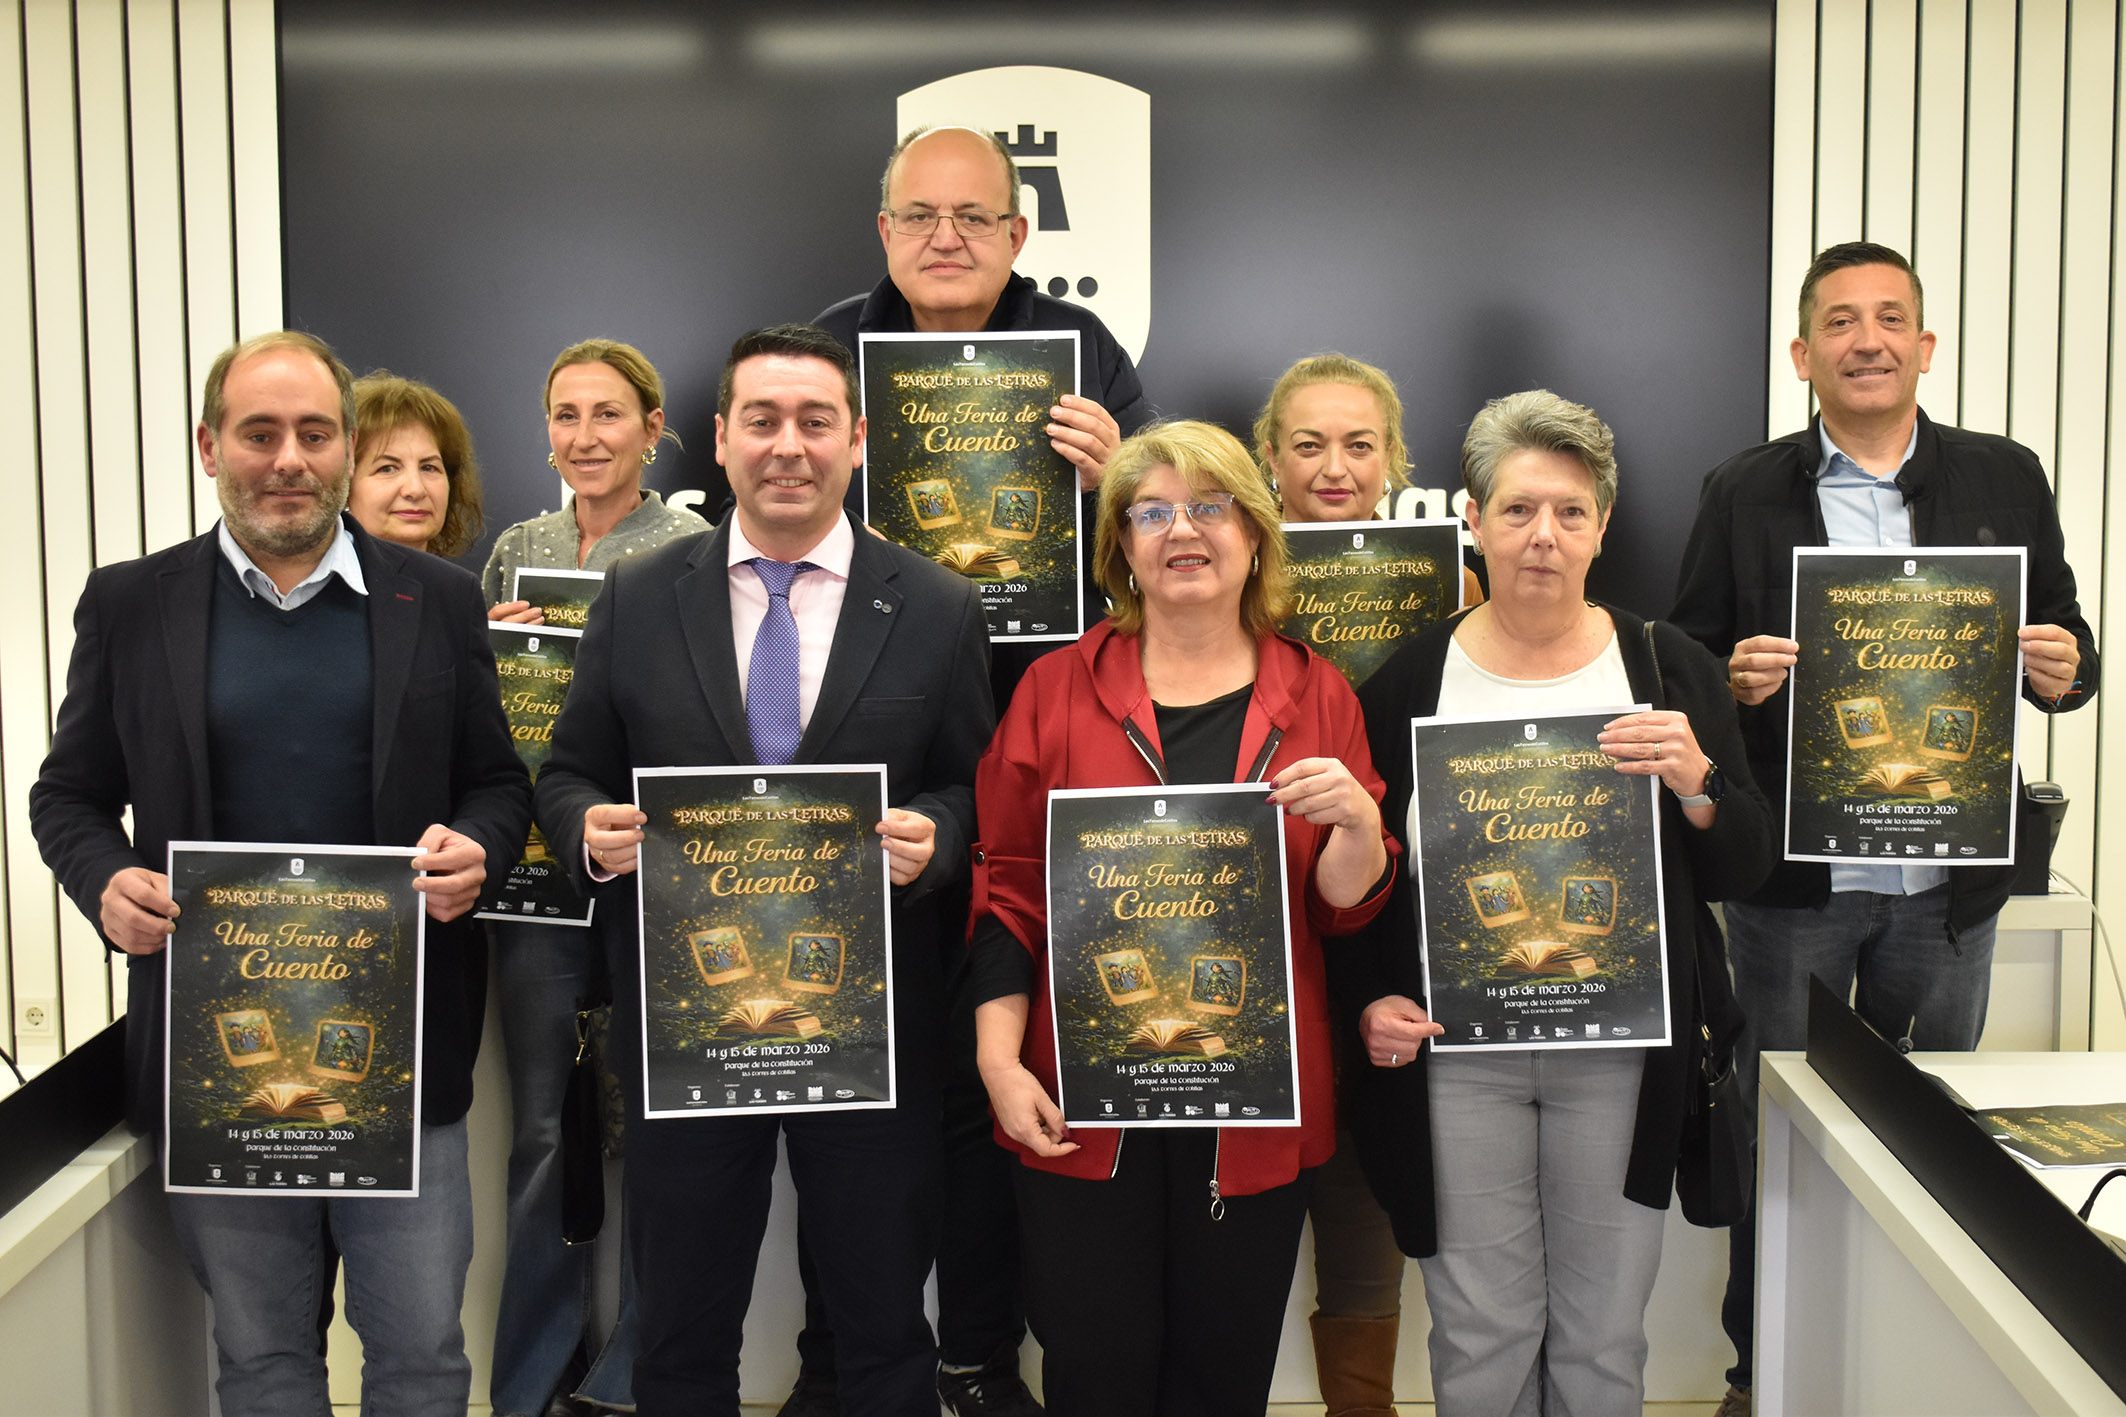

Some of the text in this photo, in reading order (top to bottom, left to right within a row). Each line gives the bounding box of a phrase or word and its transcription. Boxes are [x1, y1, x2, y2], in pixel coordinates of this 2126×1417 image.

[957, 377, 971, 385] DE
[993, 374, 1047, 388] LETRAS
[901, 403, 1038, 424] Una Feria de
[924, 426, 1020, 451] Cuento
[1345, 566, 1359, 575] DE
[1362, 566, 1380, 574] LAS
[1380, 561, 1433, 576] LETRAS
[980, 583, 1028, 593] rzo 2026
[1895, 593, 1910, 601] DE
[1913, 594, 1933, 602] LAS
[1933, 590, 1991, 605] LETRAS
[1291, 591, 1423, 615] Una Feria de
[545, 608, 588, 623] PARQU
[1311, 616, 1404, 644] Cuento
[1834, 619, 1980, 641] Una Feria de
[1857, 643, 1960, 671] Cuento
[518, 668, 532, 676] DE
[535, 669, 552, 679] LAS
[510, 692, 561, 715] Feria
[509, 719, 555, 742] ent
[1518, 759, 1533, 768] DE
[1537, 758, 1558, 767] LAS
[1459, 785, 1610, 813] Una Feria de
[746, 812, 762, 820] DE
[766, 812, 788, 820] LAS
[788, 807, 850, 822] LETRAS
[1843, 804, 1958, 815] 14 y 15 de marzo 2026
[1485, 811, 1591, 843] Cuento
[1148, 836, 1162, 845] DE
[1166, 836, 1186, 844] LAS
[1187, 830, 1246, 847] LETRAS
[683, 839, 840, 864] Una Feria de
[527, 866, 549, 876] 2026
[1088, 864, 1238, 888] Una Feria de
[710, 866, 820, 896] Cuento
[281, 894, 298, 904] DE
[301, 896, 323, 905] LAS
[323, 893, 387, 910] LETRAS
[1114, 890, 1219, 920] Cuento
[214, 922, 375, 949] Una Feria de
[240, 949, 353, 981] Cuento
[1486, 983, 1606, 999] 14 y 15 de marzo 2026
[706, 1043, 830, 1060] 14 y 15 de marzo 2026
[1116, 1062, 1235, 1076] 14 y 15 de marzo 2026
[228, 1128, 355, 1142] 14 y 15 de marzo 2026
